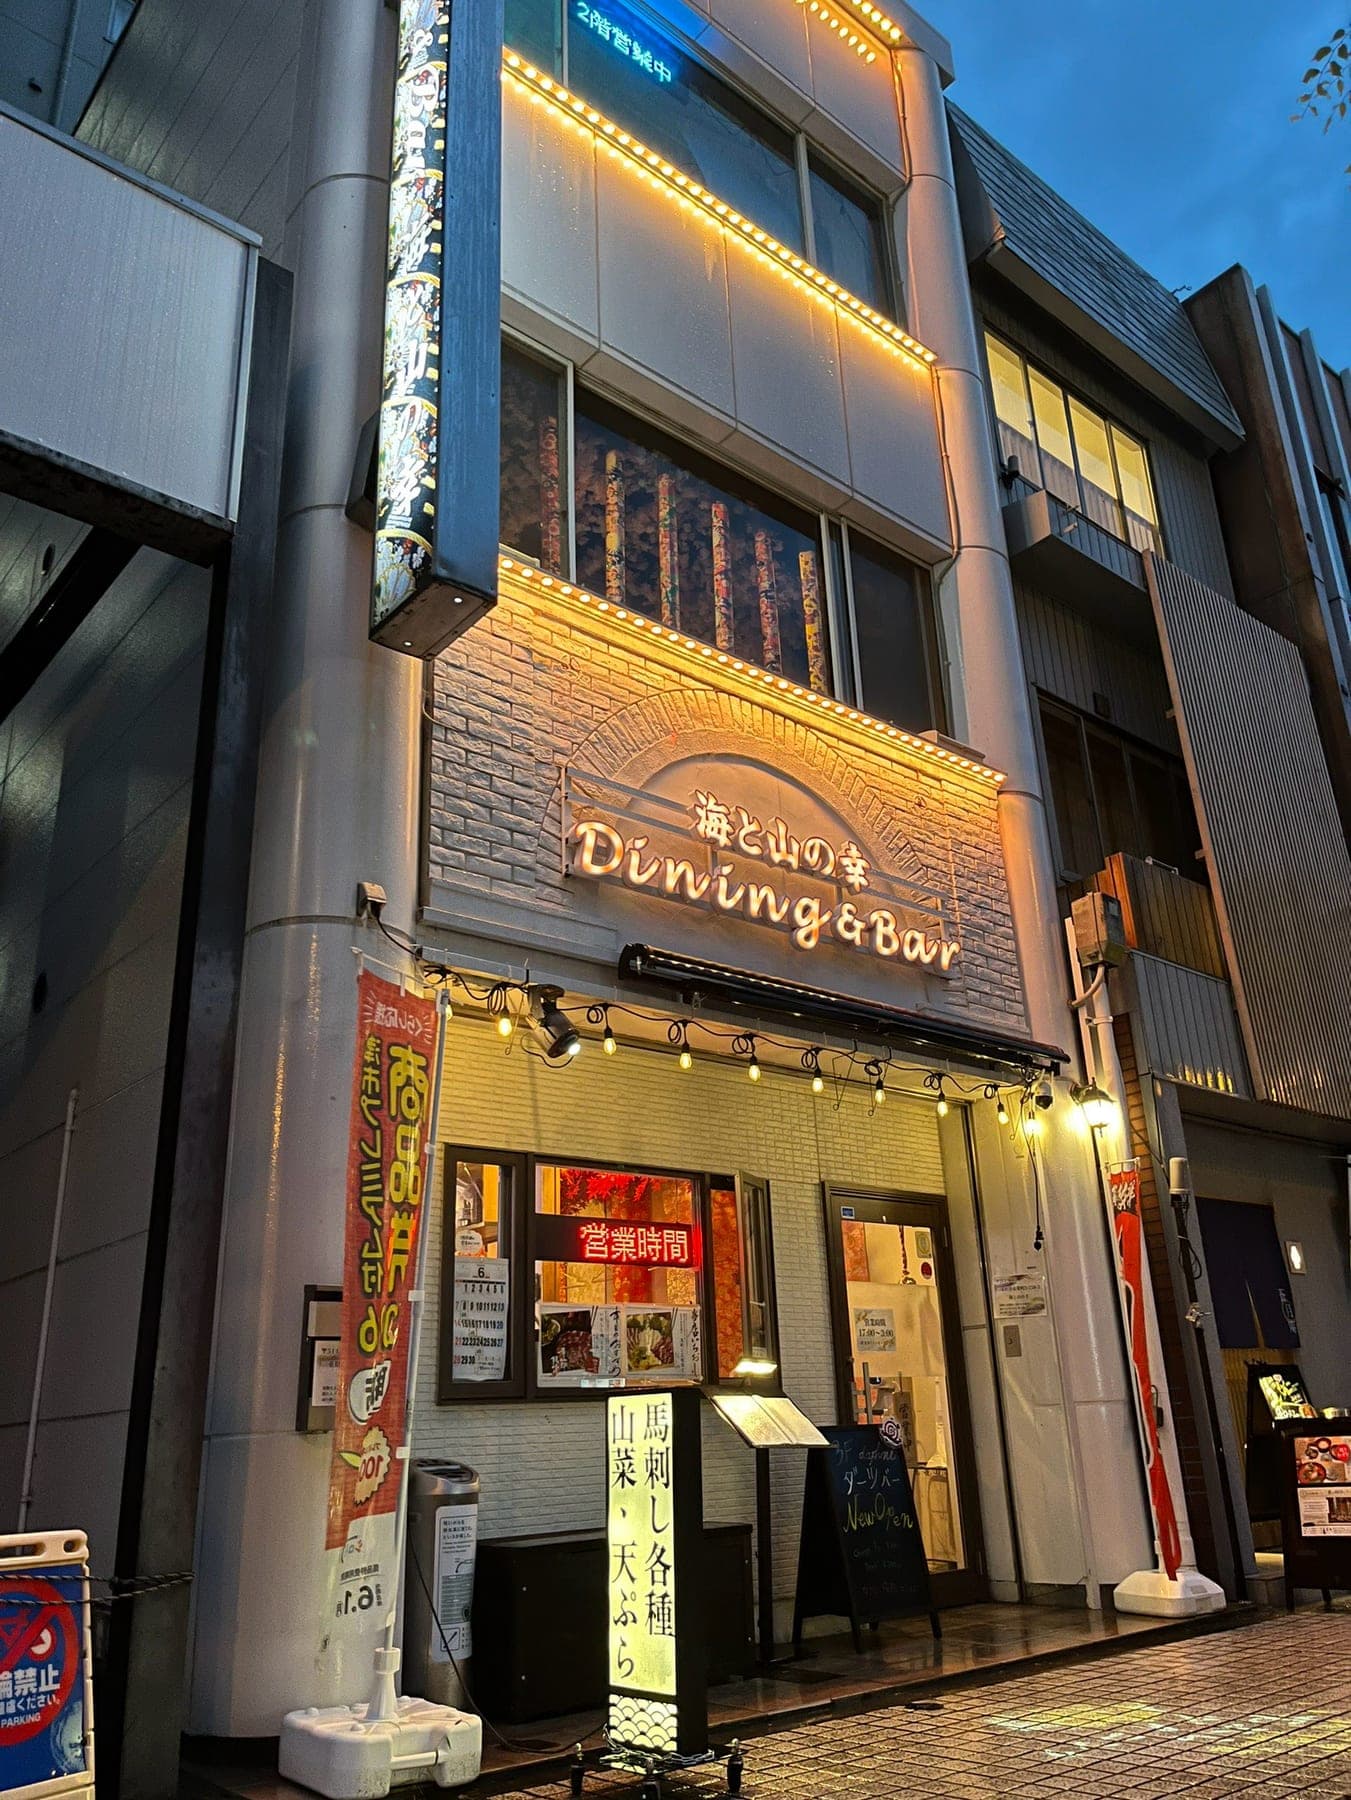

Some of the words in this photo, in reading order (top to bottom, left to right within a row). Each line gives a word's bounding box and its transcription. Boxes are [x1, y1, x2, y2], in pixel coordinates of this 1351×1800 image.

[576, 1, 673, 83] 2階営業中
[693, 788, 870, 894] 海と山の幸
[575, 820, 831, 951] Dining
[836, 902, 865, 946] &
[869, 909, 961, 971] Bar
[580, 1222, 689, 1263] 営業時間
[644, 1402, 675, 1638] 馬刺し各種
[843, 1465, 900, 1496] ダーツバー
[611, 1404, 638, 1679] 山菜、天ぷら
[1, 1712, 41, 1729] PARKING
